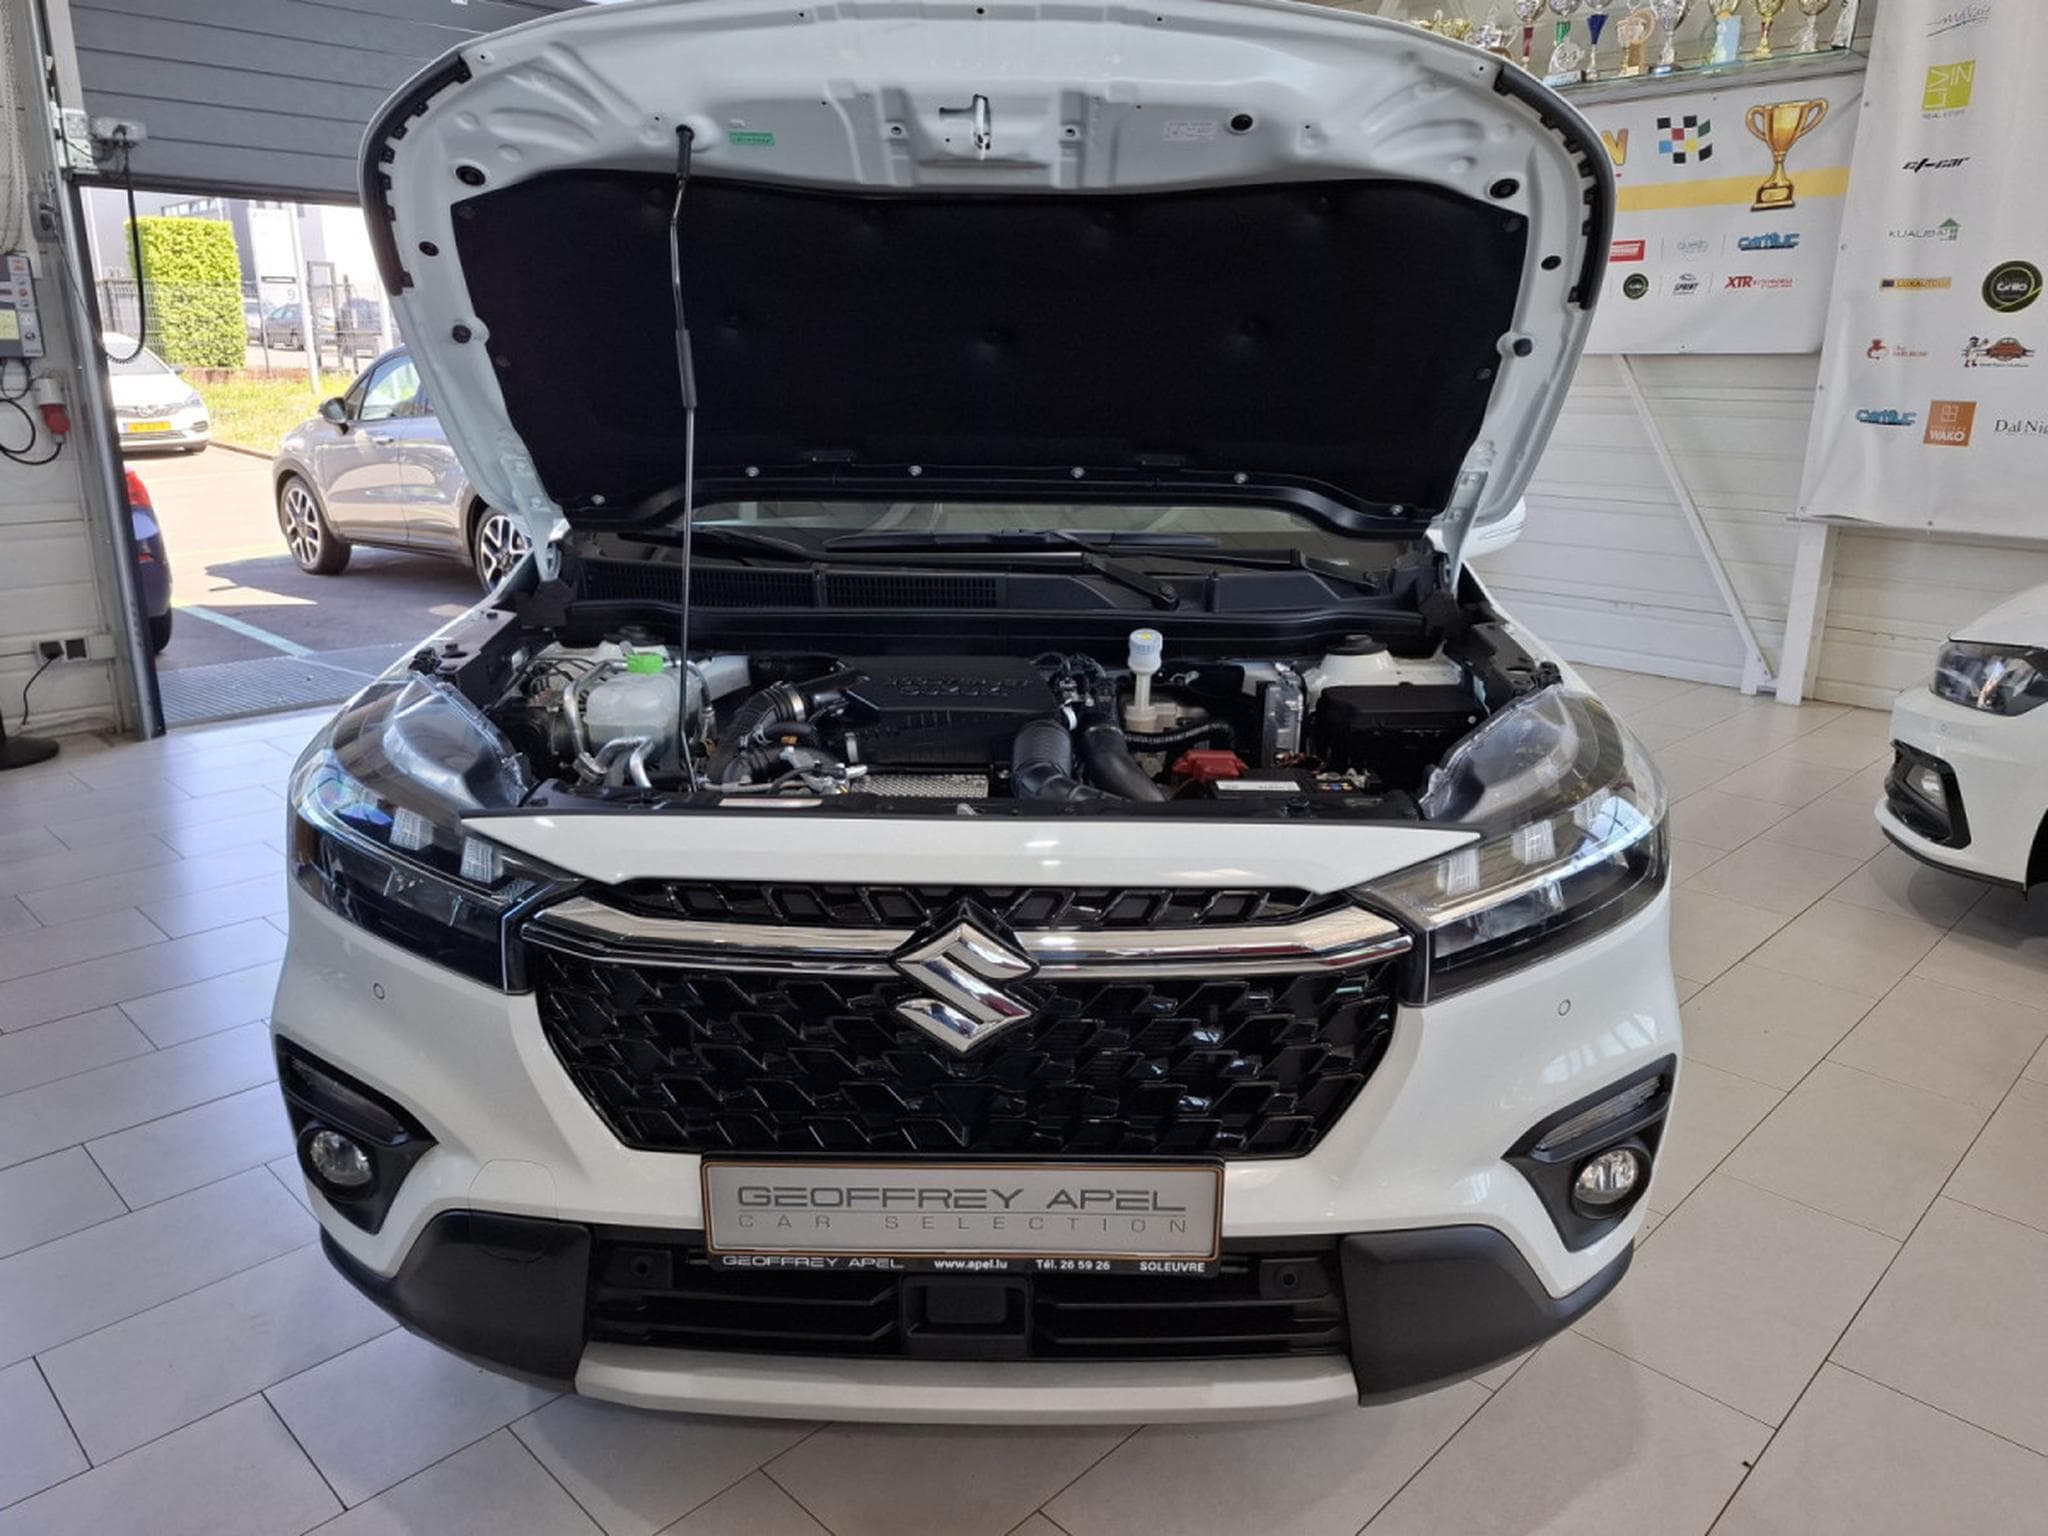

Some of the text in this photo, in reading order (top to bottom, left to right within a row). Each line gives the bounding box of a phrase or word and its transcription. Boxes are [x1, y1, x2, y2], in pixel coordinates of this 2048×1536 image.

[1724, 275, 1753, 289] XTR
[1993, 419, 2022, 432] Dal
[1929, 430, 1966, 442] WAKO
[738, 1186, 1186, 1211] GEOFFREY APEL
[739, 1215, 1186, 1233] CAR SELECTION
[722, 1256, 904, 1269] GEOFFREY APEL
[934, 1258, 1007, 1271] www.apel.lu
[1036, 1259, 1111, 1270] Tél. 26 59 26
[1139, 1261, 1205, 1273] SOLEUVRE
